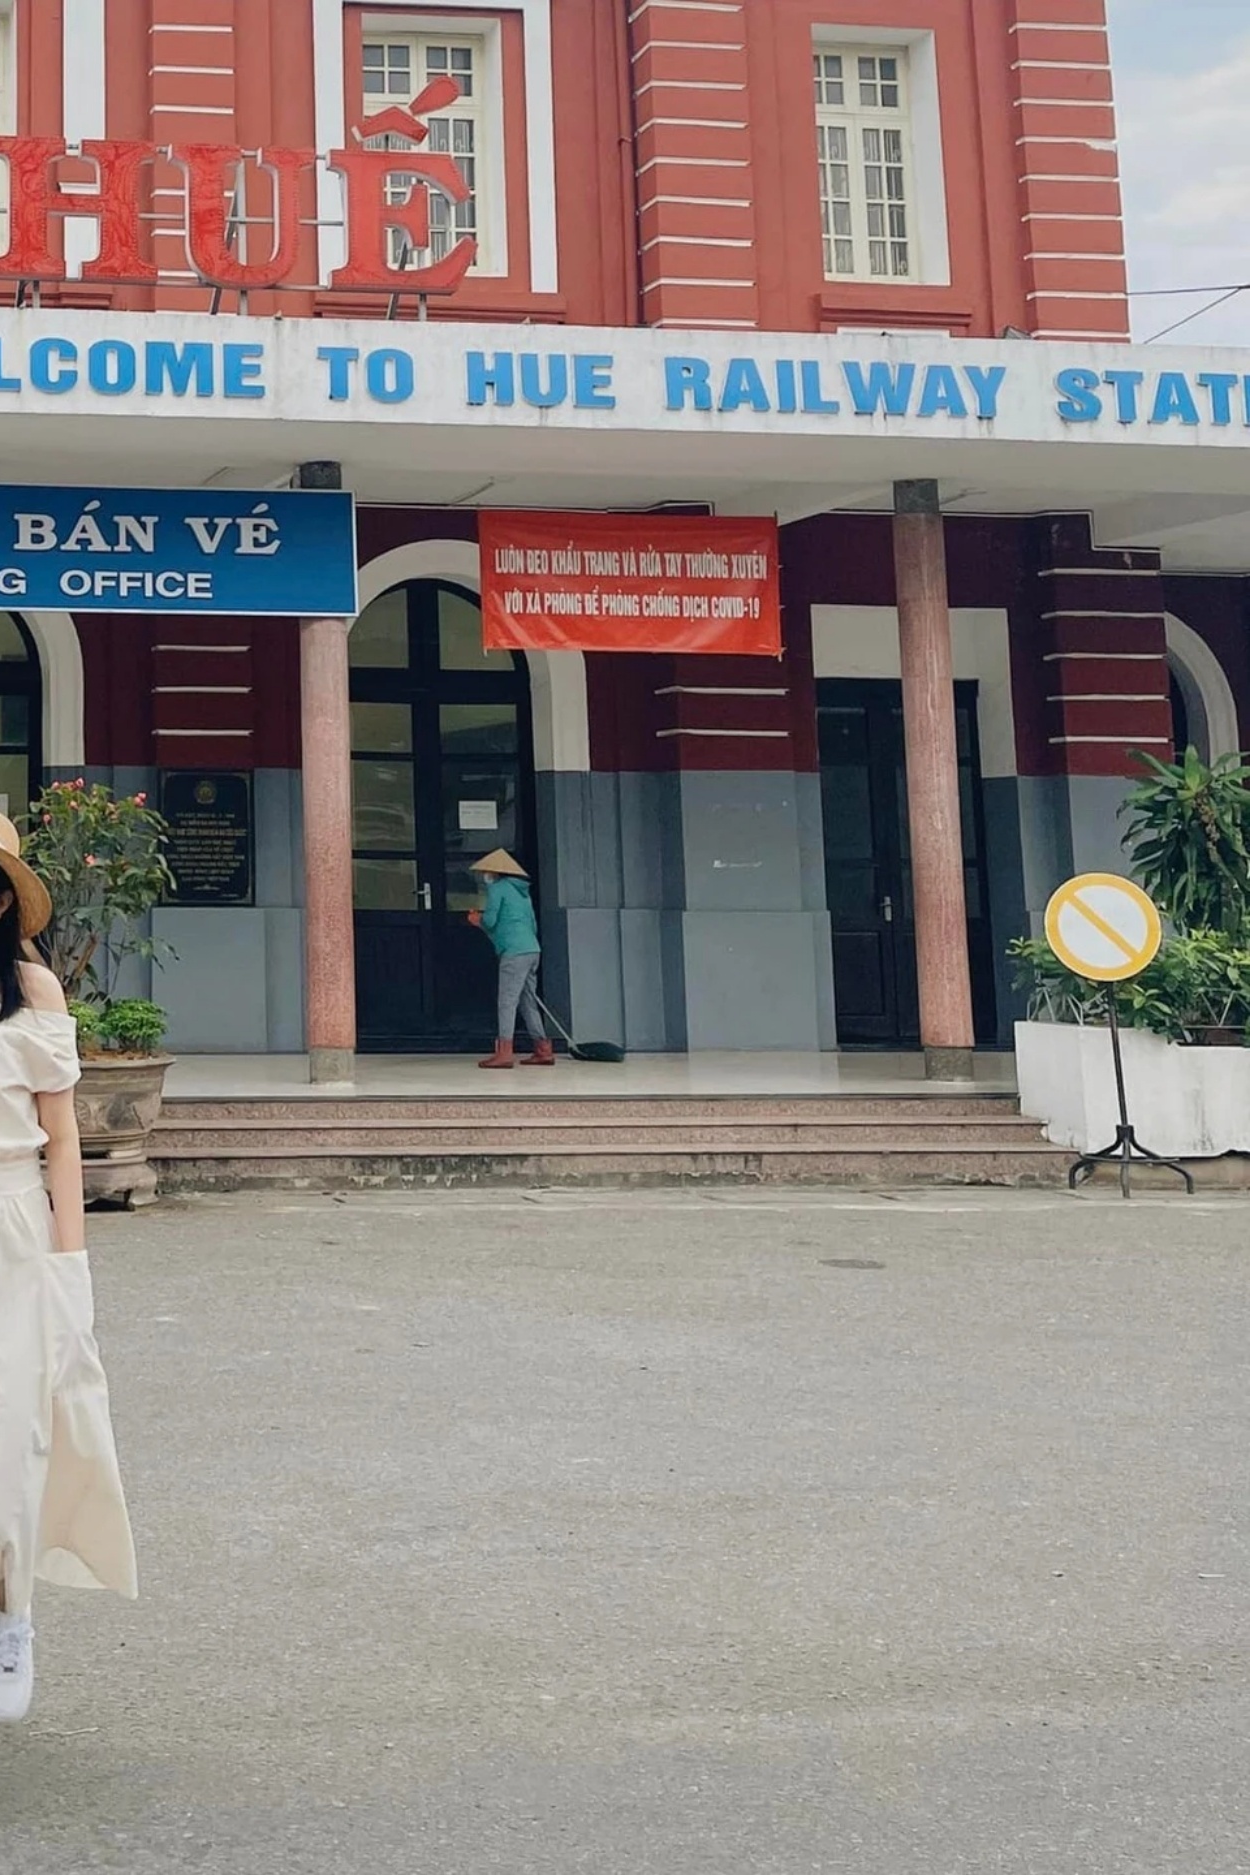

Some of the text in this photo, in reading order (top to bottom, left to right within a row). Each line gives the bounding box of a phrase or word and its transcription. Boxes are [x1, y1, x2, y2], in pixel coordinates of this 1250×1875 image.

[317, 346, 415, 404] TO
[466, 351, 616, 409] HUE
[664, 357, 1006, 420] RAILWAY
[13, 500, 159, 553] BÁN
[184, 503, 282, 555] VÉ
[495, 544, 524, 574] LUÔN
[526, 549, 549, 574] ĐEO
[583, 551, 620, 576] TRANG
[622, 546, 638, 576] VÀ
[664, 552, 682, 577] TAY
[731, 550, 767, 580] XUYÊN
[59, 569, 214, 599] OFFICE
[526, 588, 542, 614] XÀ
[544, 588, 582, 615] PHÒNG
[601, 589, 640, 617] PHÒNG
[642, 588, 681, 617] CHỐNG
[682, 596, 709, 622] DỊCH
[711, 596, 761, 619] COVID-19
